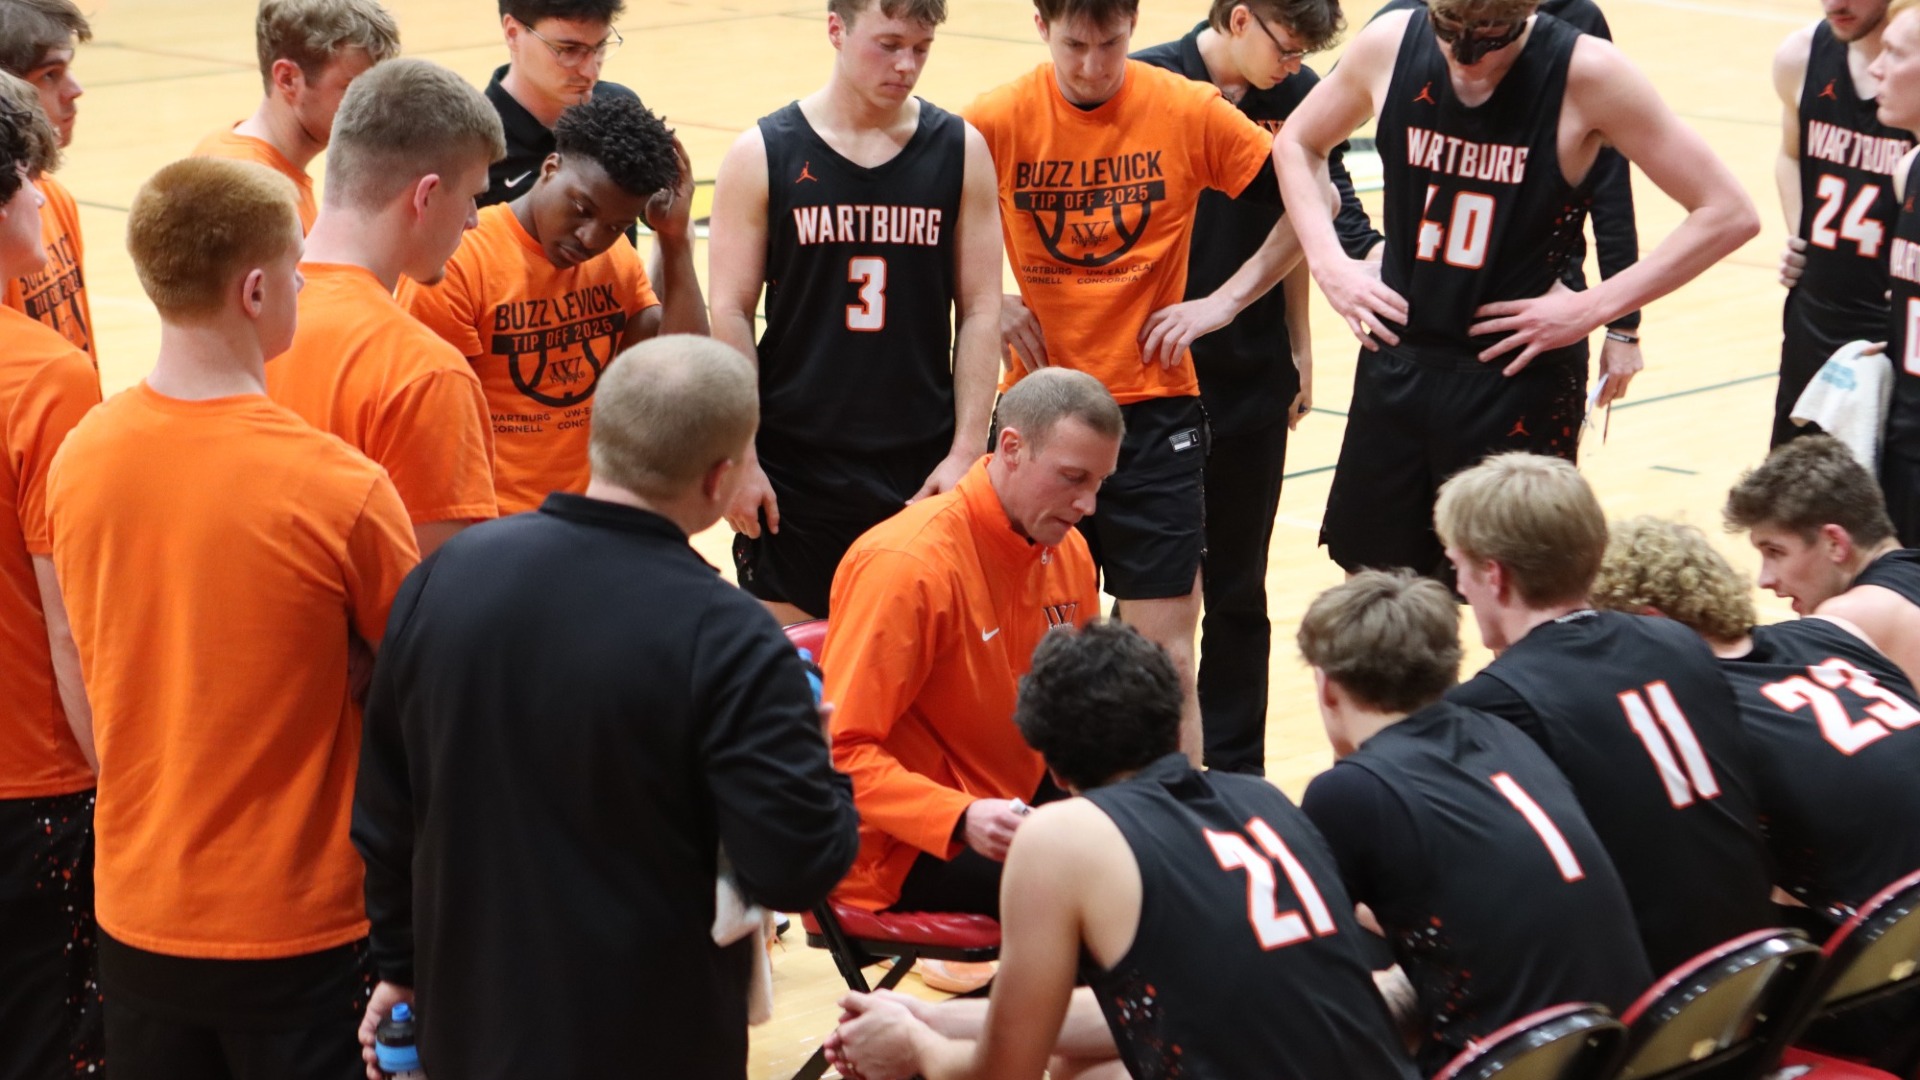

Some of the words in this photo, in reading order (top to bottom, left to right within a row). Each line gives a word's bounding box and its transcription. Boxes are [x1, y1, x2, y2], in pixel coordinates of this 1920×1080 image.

[1016, 162, 1074, 189] BUZZ
[1081, 150, 1163, 187] LEVICK
[1029, 194, 1057, 208] TIP
[1065, 193, 1095, 208] OFF
[1104, 185, 1149, 205] 2025
[793, 204, 942, 246] WARTBURG
[1415, 183, 1497, 270] 40
[1810, 172, 1886, 259] 24
[494, 299, 551, 332] BUZZ
[552, 283, 621, 322] LEVICK
[846, 255, 888, 332] 3
[1077, 275, 1139, 284] CONCORDIA
[512, 335, 539, 351] TIP
[546, 328, 569, 347] OFF
[574, 318, 613, 341] 2025
[1616, 679, 1722, 810] 11
[1759, 656, 1920, 756] 23
[1489, 771, 1586, 883] 1
[1202, 816, 1338, 950] 21
